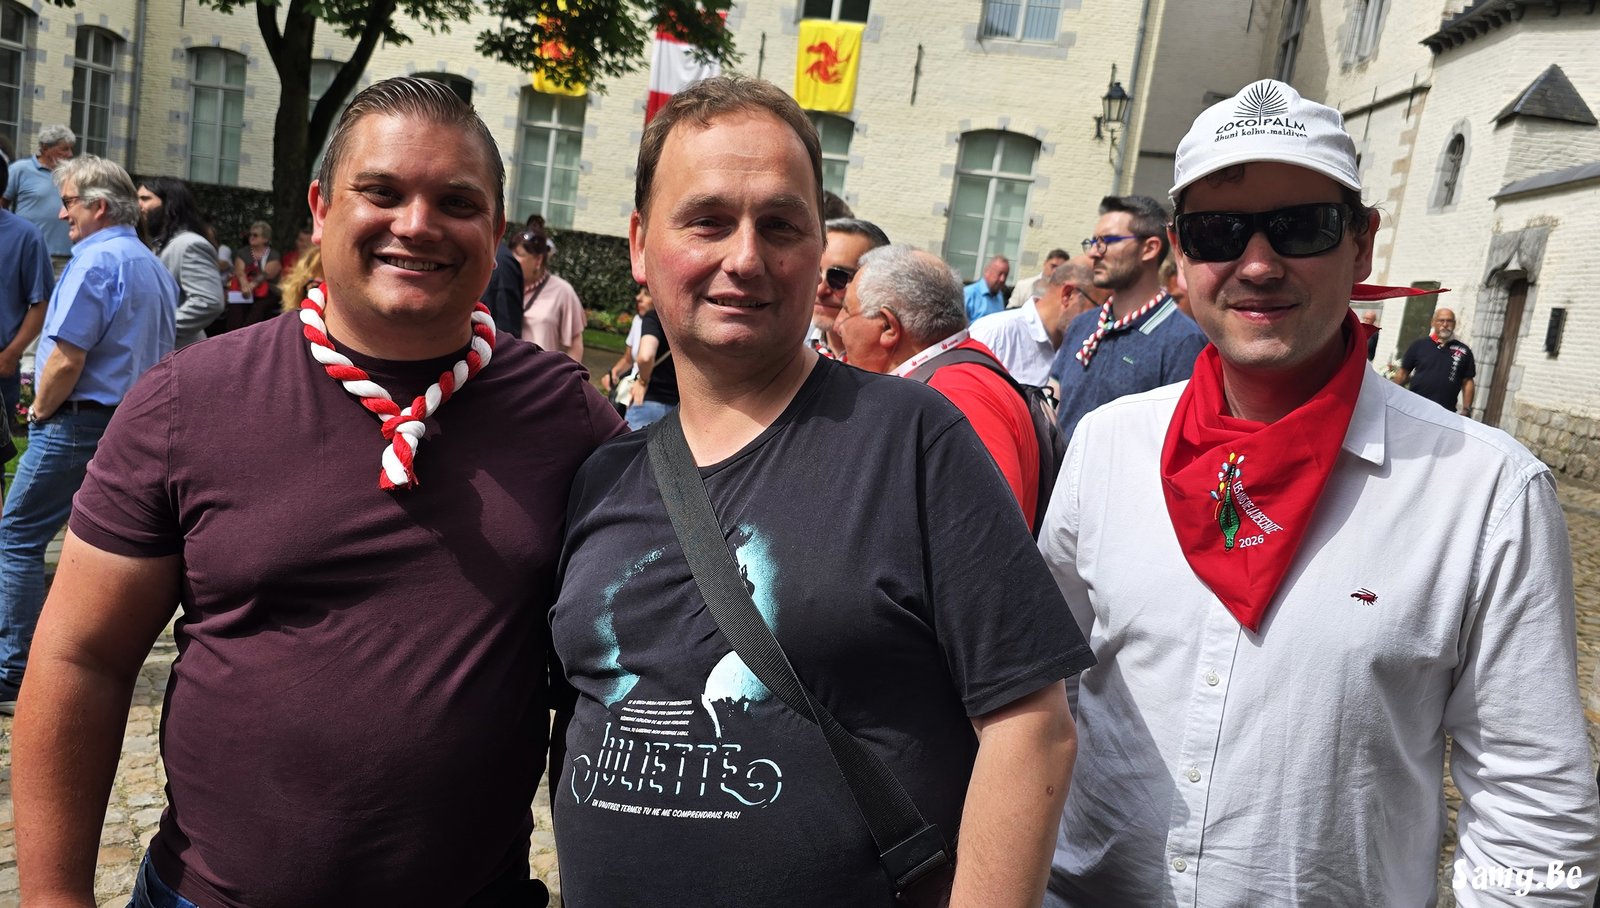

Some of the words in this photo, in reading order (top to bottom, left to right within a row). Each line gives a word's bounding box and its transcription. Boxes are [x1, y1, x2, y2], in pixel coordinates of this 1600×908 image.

[1216, 119, 1257, 134] COCO
[1264, 117, 1306, 132] PALM
[1239, 535, 1264, 548] 2026
[620, 804, 642, 814] TERMES
[642, 807, 652, 815] TU
[651, 808, 661, 816] NE
[660, 809, 672, 817] ME
[672, 809, 722, 819] COMPRENDRAIS
[723, 811, 741, 819] PAS!
